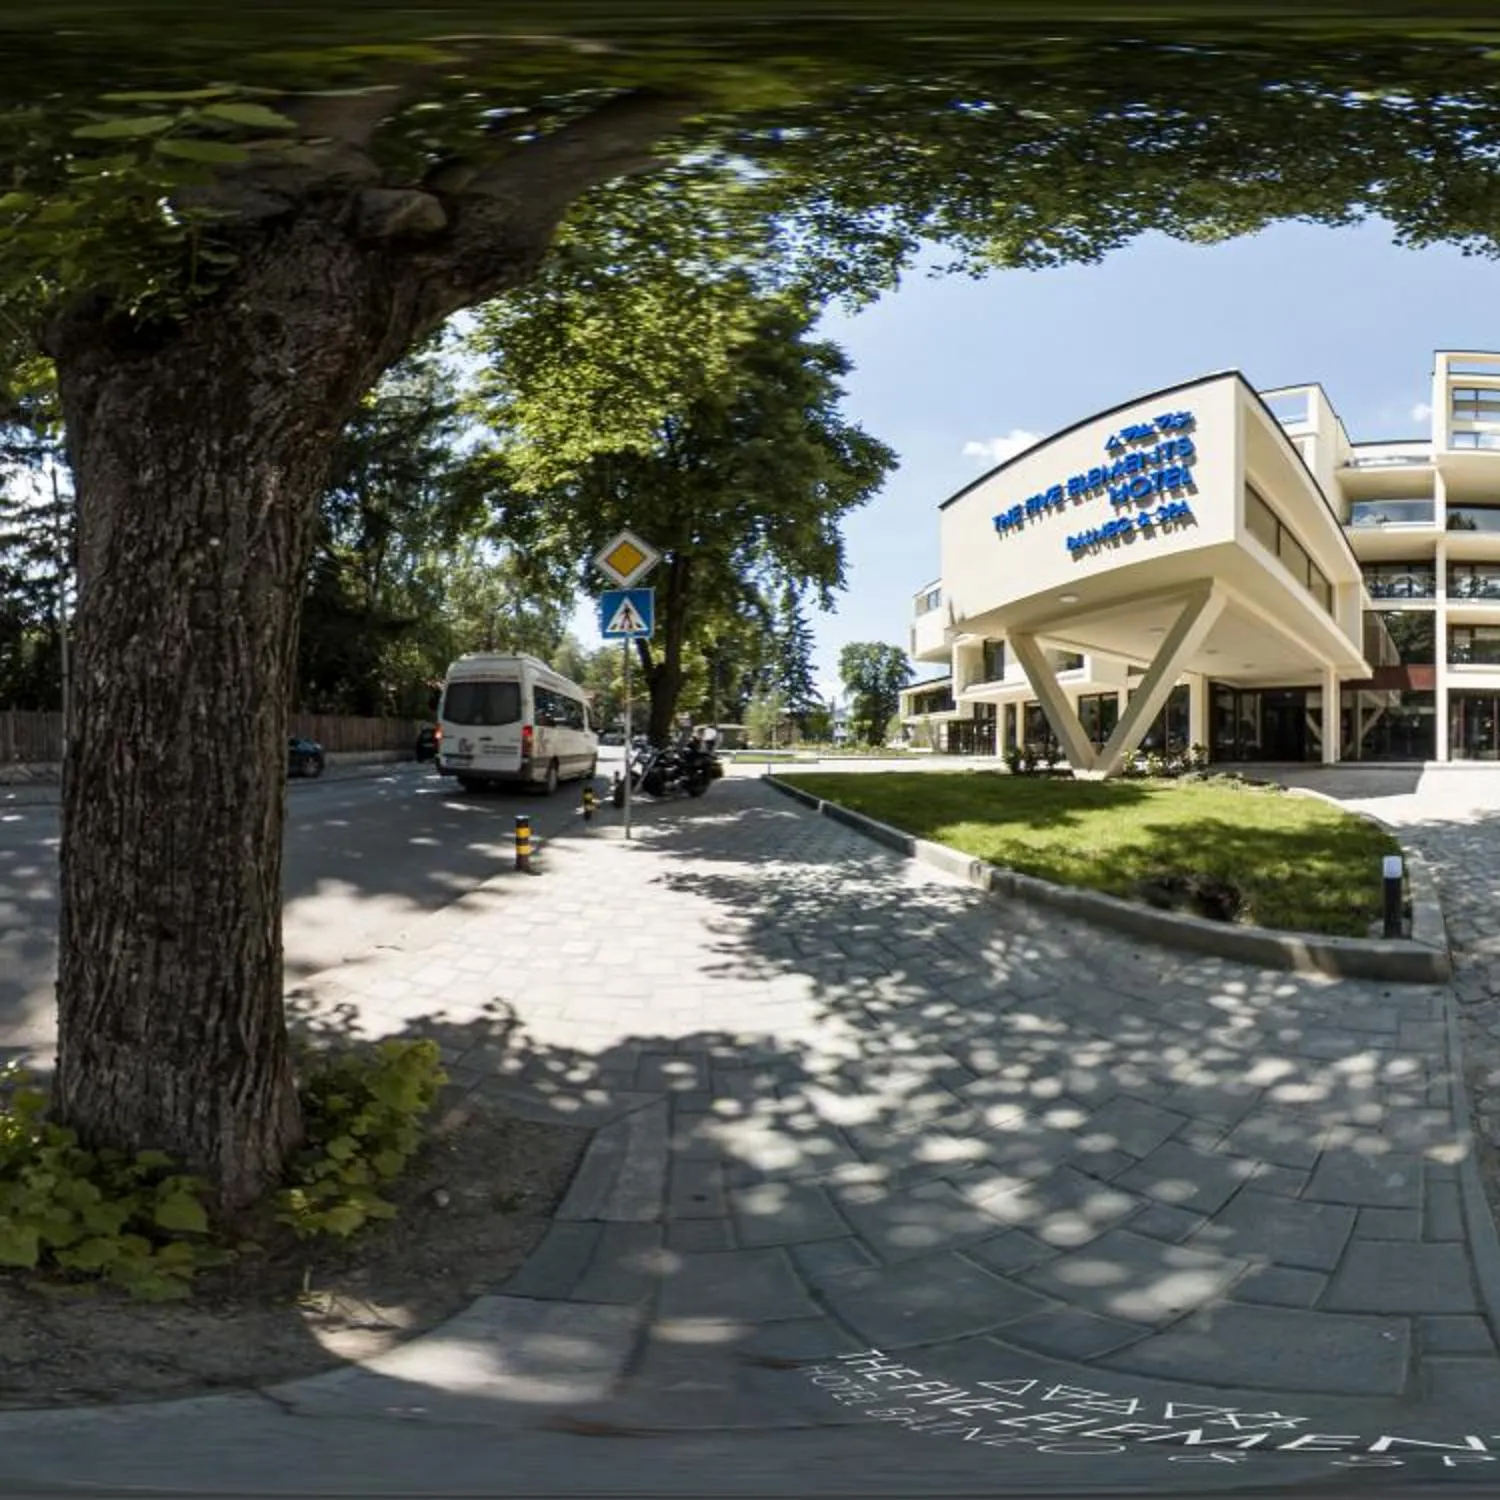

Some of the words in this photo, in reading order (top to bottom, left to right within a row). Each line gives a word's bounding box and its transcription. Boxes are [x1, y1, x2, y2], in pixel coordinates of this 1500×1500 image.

[992, 505, 1023, 535] THE
[1026, 484, 1065, 514] FIVE
[1067, 436, 1195, 496] ELEMENTS
[1109, 464, 1193, 506] HOTEL
